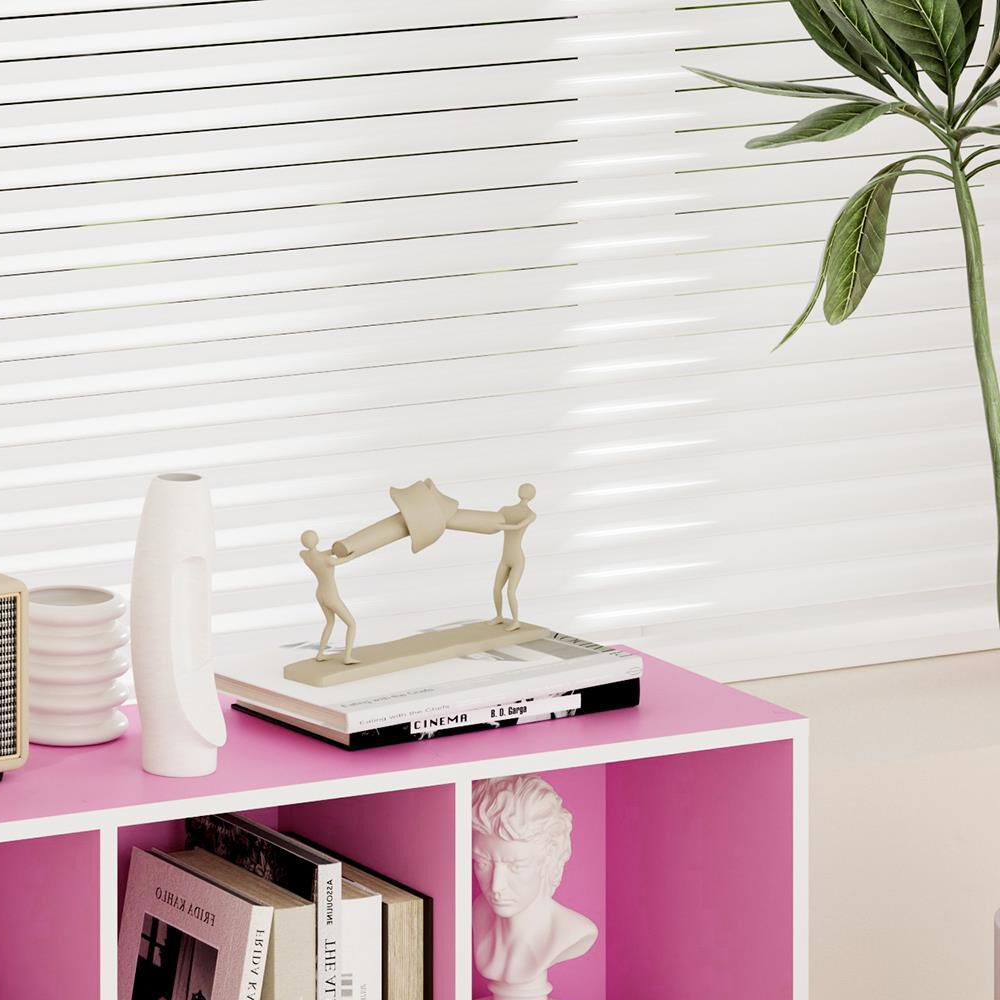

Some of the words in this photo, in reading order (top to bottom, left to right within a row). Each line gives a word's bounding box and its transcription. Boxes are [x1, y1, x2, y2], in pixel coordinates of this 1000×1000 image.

[490, 708, 498, 719] B.
[499, 707, 507, 717] D.
[508, 704, 528, 716] Garga
[413, 713, 468, 730] CINEMA
